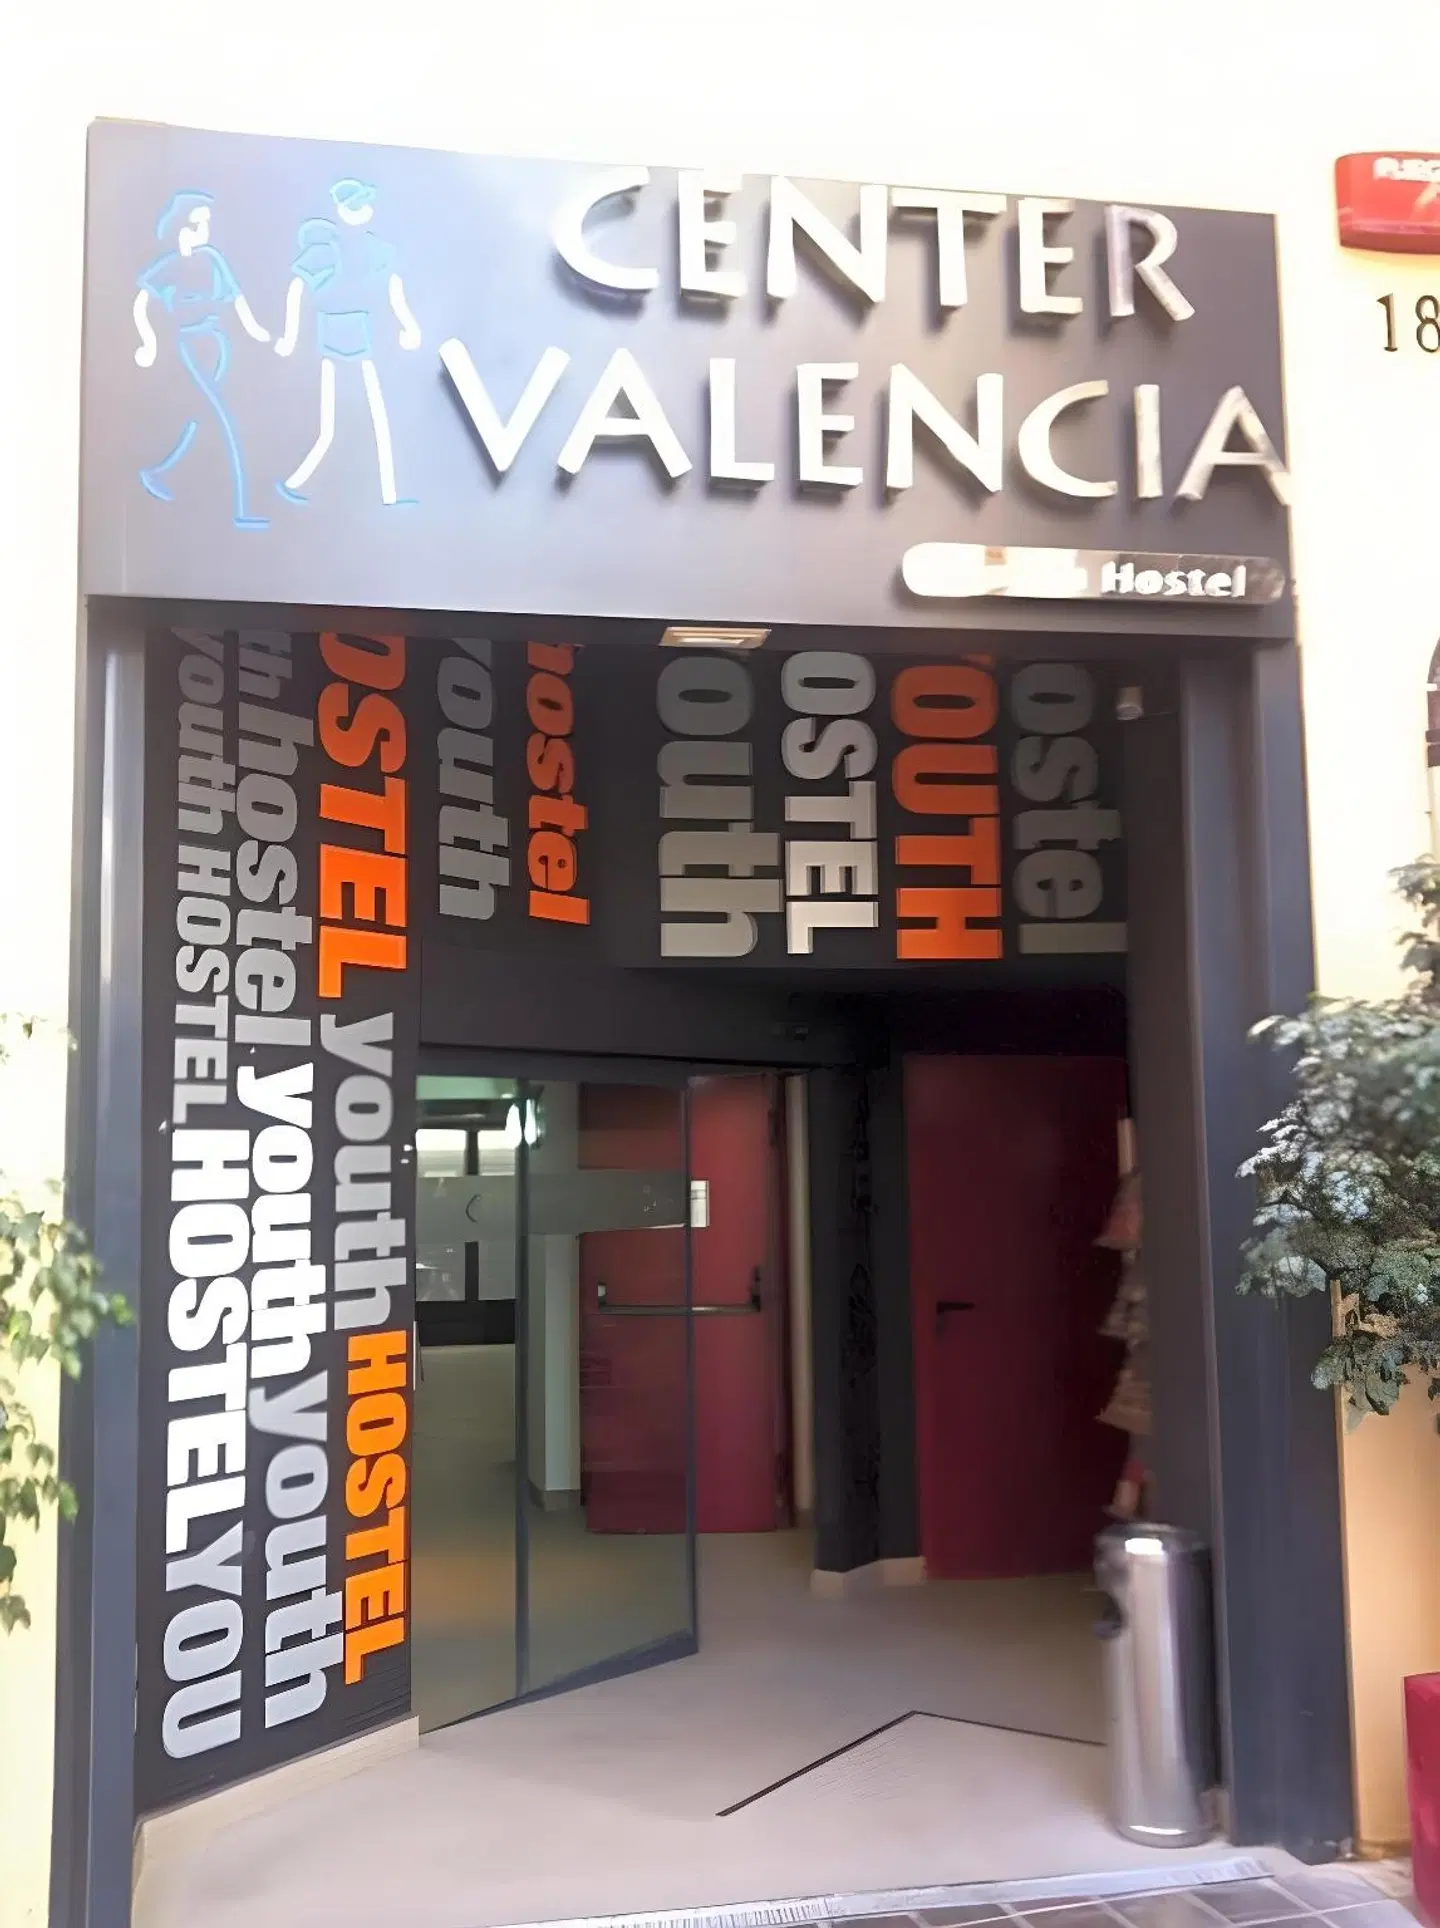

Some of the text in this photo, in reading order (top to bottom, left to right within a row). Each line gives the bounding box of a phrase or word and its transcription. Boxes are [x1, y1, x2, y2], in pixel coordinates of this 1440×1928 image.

[553, 166, 1195, 321] CENTER
[438, 337, 1291, 506] VALENCIA
[1101, 561, 1247, 598] Hostel
[235, 701, 314, 1047] hostel
[656, 655, 784, 957] outh
[781, 650, 879, 955] OSTEL
[890, 655, 1003, 960] OUTH
[1010, 662, 1129, 954] ostel
[172, 843, 231, 1124] HOSTEL
[236, 1062, 327, 1379] youth
[318, 632, 410, 1686] OSTEL youth HOSTEL
[165, 1129, 250, 1555] HOSTEL
[161, 1519, 244, 1759] YOU
[249, 1369, 344, 1728] youth
